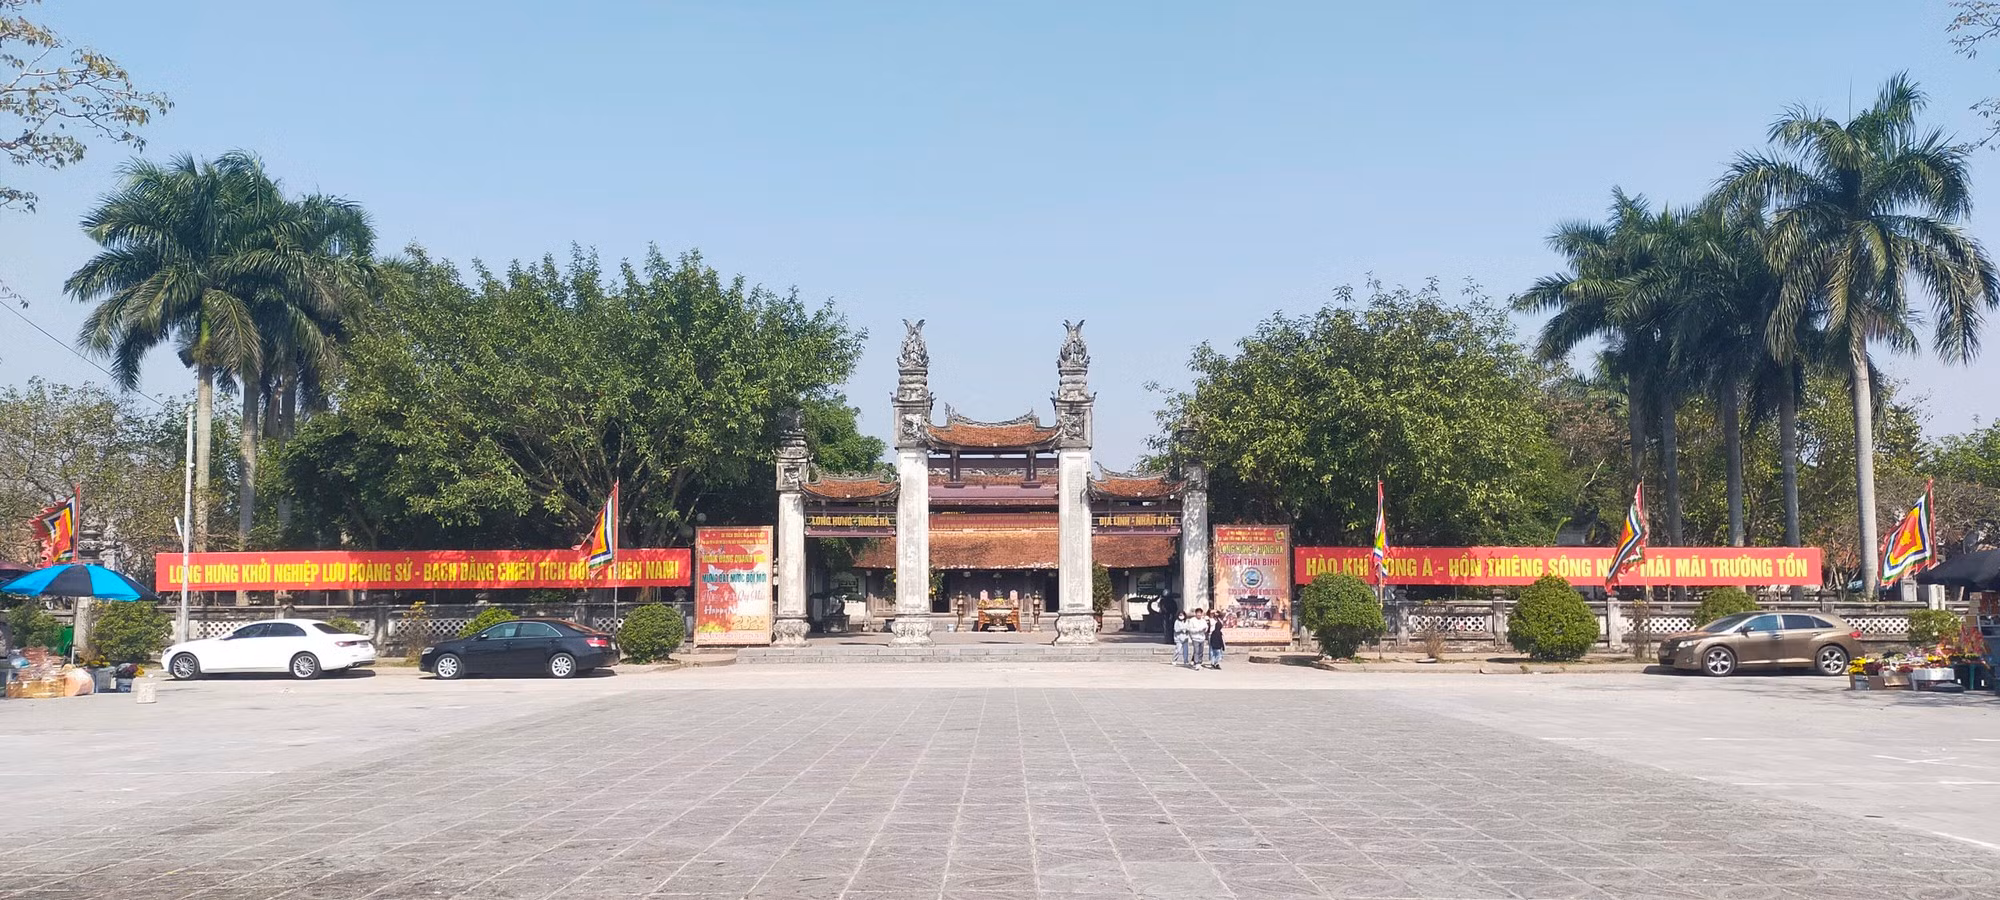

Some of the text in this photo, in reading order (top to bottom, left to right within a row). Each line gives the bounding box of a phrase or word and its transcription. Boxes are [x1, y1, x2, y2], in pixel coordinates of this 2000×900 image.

[811, 516, 832, 526] LONG
[1113, 517, 1129, 526] LINH
[169, 564, 201, 584] LONG
[204, 562, 239, 583] HƯNG
[242, 558, 271, 583] KHỞI
[274, 560, 319, 587] NGHIỆP
[349, 560, 391, 582] HOÀNG
[394, 557, 413, 582] SỬ
[423, 562, 457, 586] BẠCH
[498, 556, 535, 581] CHIẾN
[539, 558, 567, 581] TÍCH
[1306, 554, 1338, 576] HÀO
[1343, 554, 1369, 576] KHÍ
[1448, 552, 1482, 577] HỒN
[1486, 554, 1542, 577] THIÊNG
[1548, 555, 1591, 577] SÔNG
[1675, 554, 1706, 577] MÃI
[1710, 554, 1772, 578] TRƯỜNG
